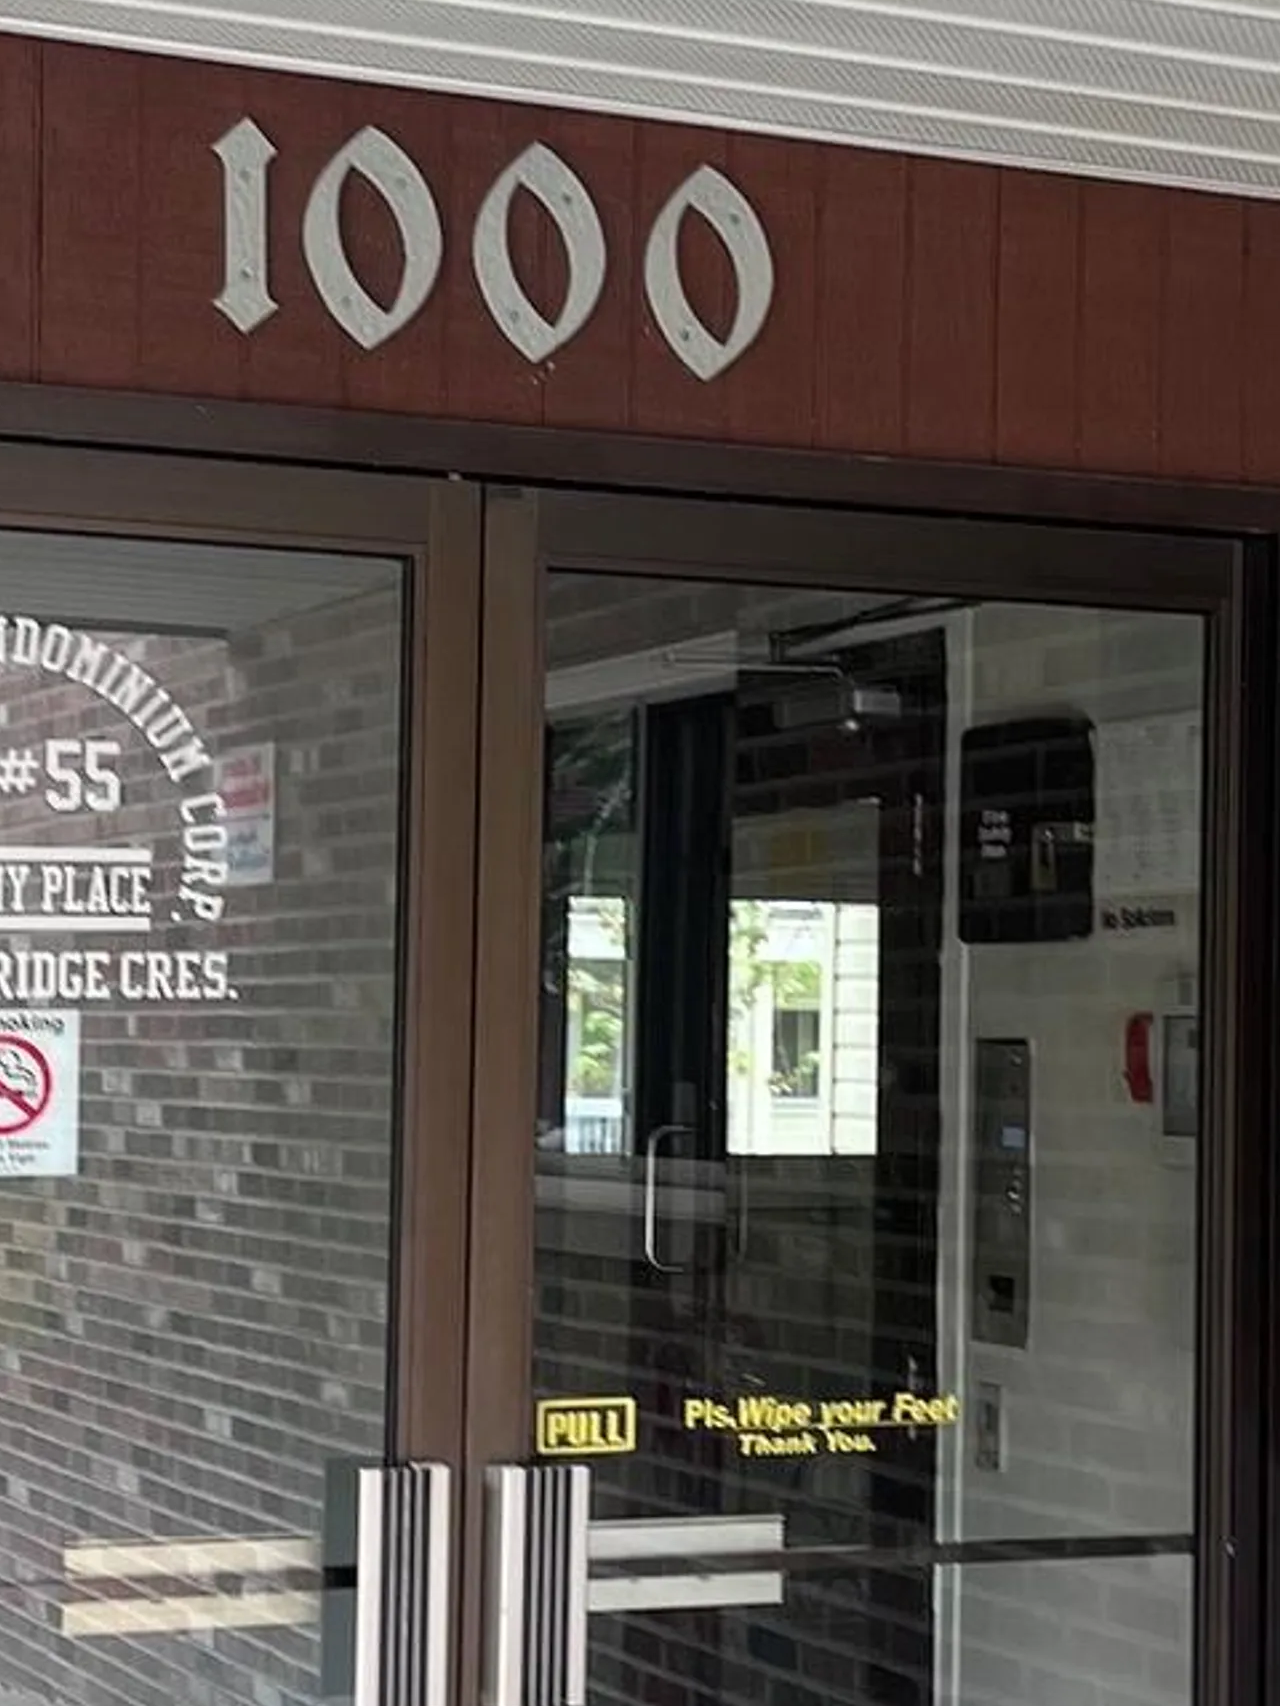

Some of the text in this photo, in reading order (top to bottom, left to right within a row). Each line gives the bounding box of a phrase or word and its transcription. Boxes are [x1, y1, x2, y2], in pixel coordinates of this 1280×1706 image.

[211, 116, 774, 382] 1000
[170, 792, 228, 923] CORP.
[40, 864, 152, 914] PLACE
[119, 950, 239, 1001] CRES.
[546, 1409, 626, 1447] PULL
[737, 1396, 812, 1432] Wipe
[820, 1401, 892, 1429] your
[892, 1393, 961, 1424] Feet
[738, 1432, 819, 1458] Thank
